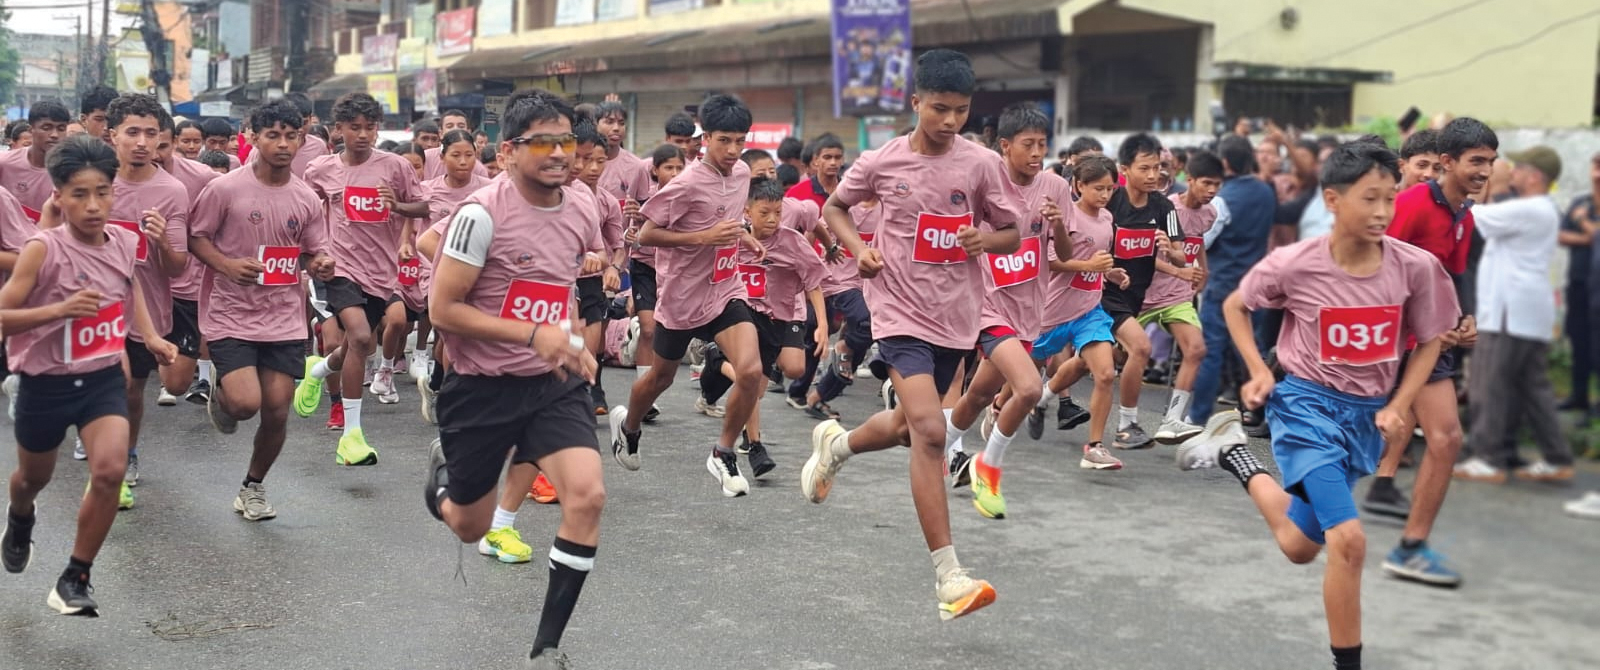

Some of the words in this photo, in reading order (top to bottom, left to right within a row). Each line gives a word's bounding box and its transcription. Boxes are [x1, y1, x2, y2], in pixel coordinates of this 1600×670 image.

[923, 228, 962, 249] १७
[1183, 242, 1201, 256] ६०
[266, 257, 297, 275] ०१५
[397, 265, 419, 278] १२
[994, 250, 1036, 274] १७१
[1080, 270, 1099, 283] १४
[511, 296, 563, 326] २०४
[1327, 320, 1393, 352] ०३८
